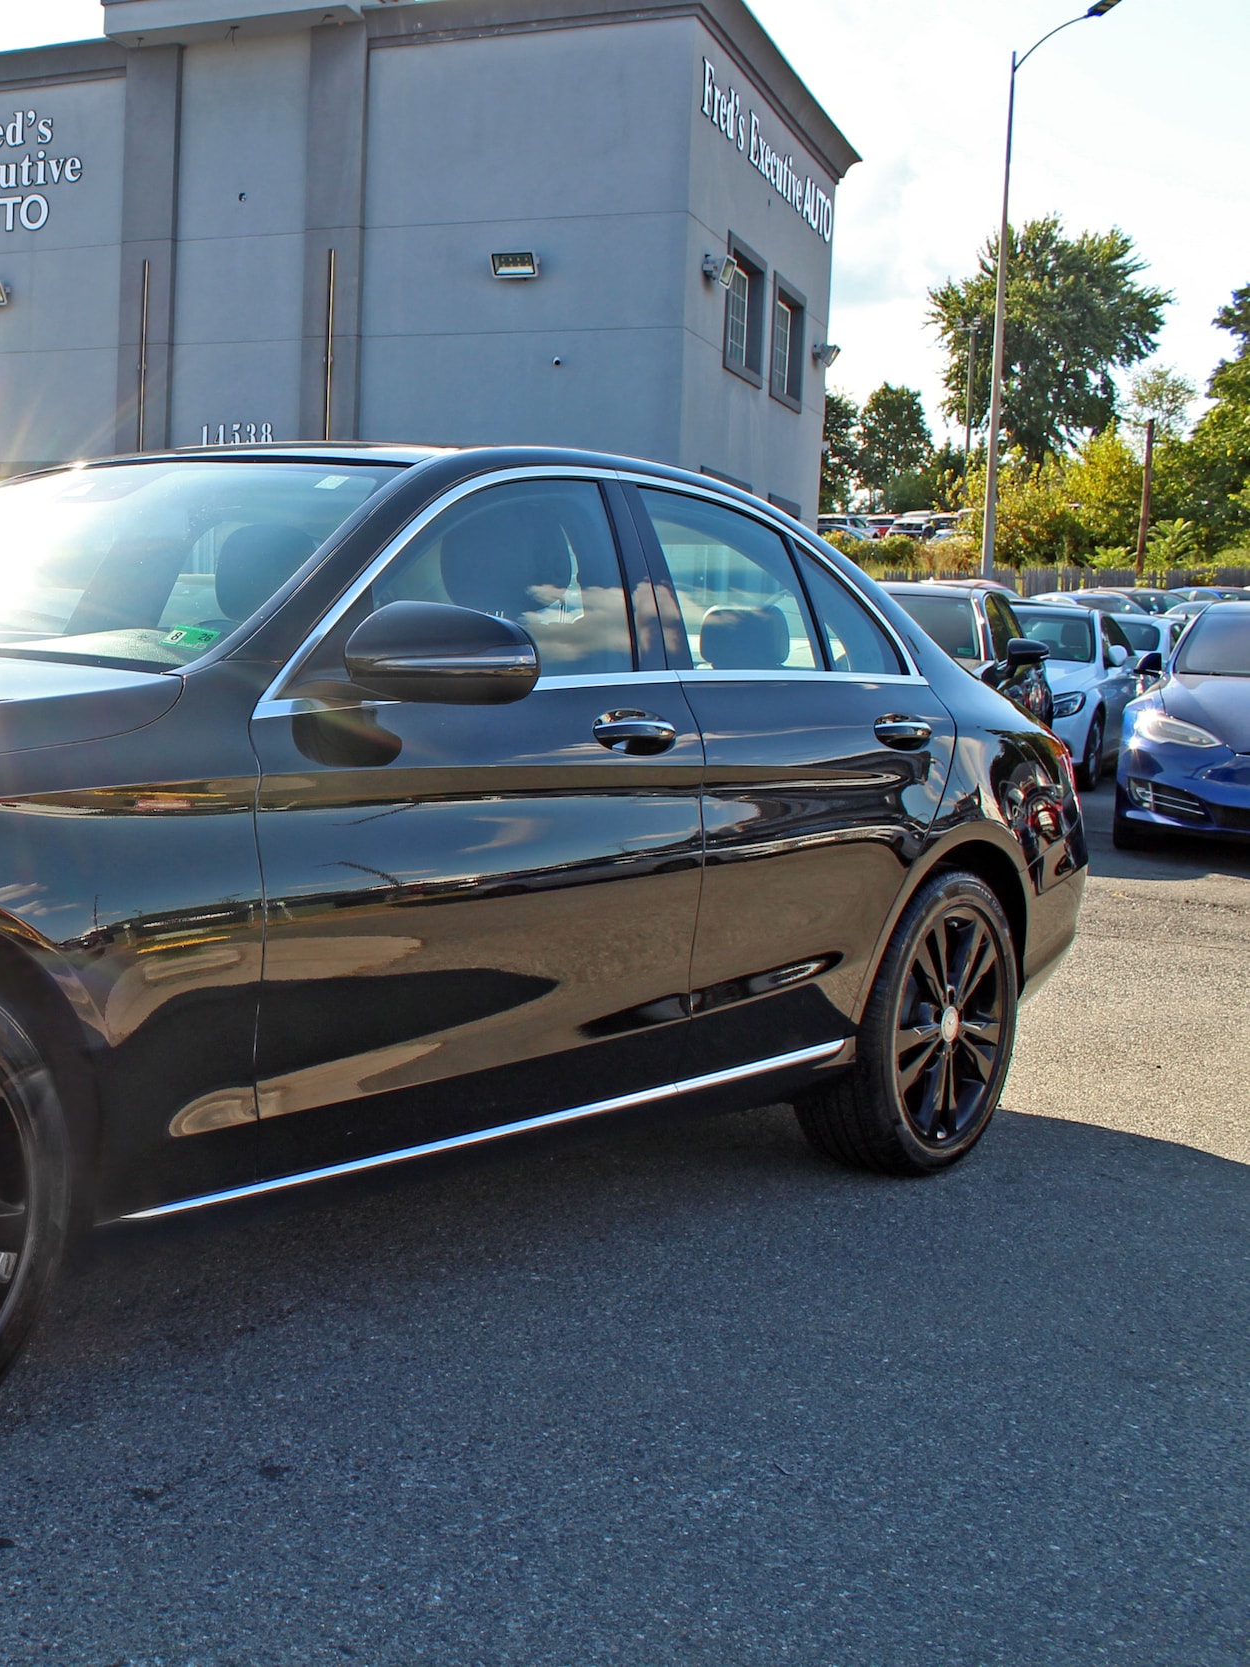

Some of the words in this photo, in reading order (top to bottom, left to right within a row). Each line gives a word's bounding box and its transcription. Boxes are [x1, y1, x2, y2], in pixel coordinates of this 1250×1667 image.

[701, 56, 745, 151] Fred's
[748, 109, 803, 212] Executive
[802, 176, 832, 243] AUTO
[201, 422, 274, 446] 14538
[170, 632, 183, 641] 8
